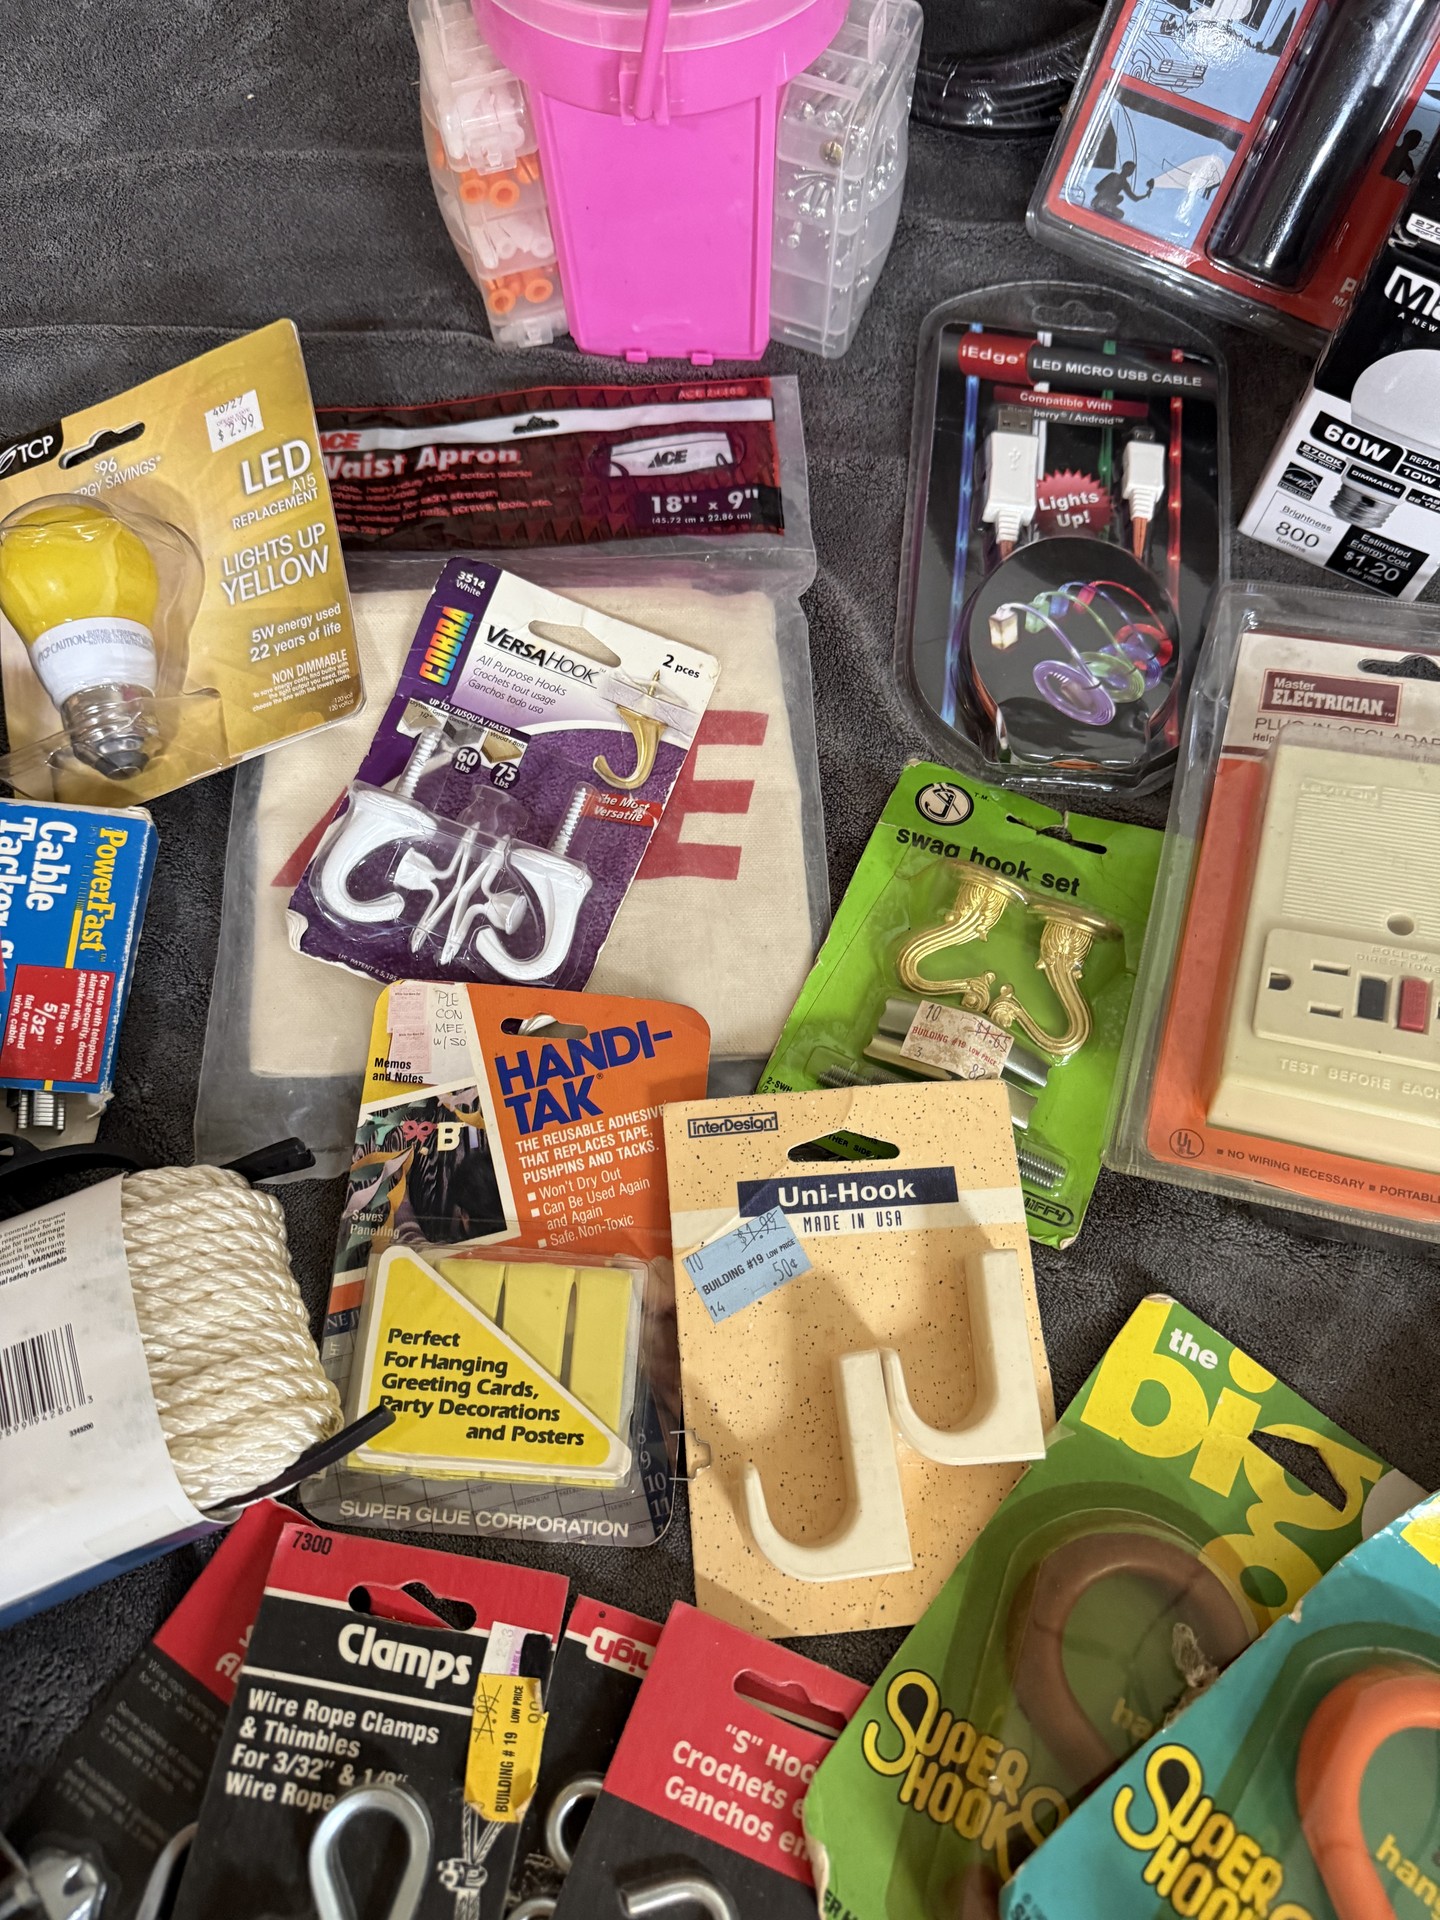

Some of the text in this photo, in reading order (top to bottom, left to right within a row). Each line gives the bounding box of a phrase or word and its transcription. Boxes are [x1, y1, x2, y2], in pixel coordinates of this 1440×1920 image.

[962, 345, 1019, 365] iEdge
[1033, 359, 1202, 388] LED MICRO USB CABLE
[1020, 391, 1112, 412] Compatible With
[17, 435, 54, 463] TCP
[1323, 423, 1391, 462] 60W
[94, 457, 118, 476] $96
[241, 439, 312, 495] LED
[415, 446, 521, 472] Apron
[648, 449, 688, 469] ACE
[292, 472, 316, 494] A15
[1351, 469, 1401, 493] DIMMABLE
[1403, 468, 1436, 485] 10W
[232, 487, 318, 530] REPLACEMENT
[651, 488, 759, 514] 18" 9"
[1039, 491, 1099, 511] Lights
[1056, 511, 1090, 528] Up!
[1282, 505, 1333, 532] Brightness
[1275, 520, 1320, 548] 800
[1361, 533, 1411, 559] Estimated
[223, 522, 326, 577] LIGHTS UP
[1350, 538, 1411, 569] Energy Cost
[220, 545, 329, 606] YELLOW
[457, 570, 487, 591] 3514
[1343, 550, 1400, 582] $1.20
[455, 579, 482, 598] White
[252, 603, 341, 643] 5W energy used
[250, 622, 342, 662] 22 years of life
[486, 624, 600, 684] VERSAHOOK
[272, 649, 348, 685] NON DIMMABLE
[476, 654, 567, 697] All Purpose Hooks
[661, 654, 701, 680] 2 pces
[468, 679, 544, 716] Ganchos todo uso
[472, 667, 556, 708] Crochets tout usage
[1274, 677, 1316, 692] Master
[1271, 688, 1384, 717] ELECTRICIAN
[454, 760, 471, 774] Lbs
[457, 749, 477, 766] 60
[499, 763, 518, 781] 75
[493, 777, 510, 789] Lbs
[26, 821, 78, 911] Cable
[896, 826, 1081, 897] swag hook set
[80, 827, 129, 952] PowerFast
[30, 1002, 58, 1042] 5/32"
[84, 974, 110, 1075] For use with telephone,
[912, 1026, 967, 1049] BUILDING #19
[374, 1057, 412, 1070] Memos
[494, 1020, 673, 1096] HANDI-
[372, 1071, 424, 1084] and Notes
[1280, 1058, 1392, 1091] TEST BEFORE
[504, 1074, 604, 1136] TAK
[516, 1119, 605, 1154] THE REUSABLE
[519, 1124, 653, 1169] THAT REPLACES TAPE,
[523, 1139, 660, 1185] PUSHPINS AND TACKS.
[1228, 1149, 1366, 1191] NO WIRING NECESSARY
[539, 1167, 622, 1201] Won't Dry Out
[543, 1177, 650, 1216] Can Be Used Again
[778, 1178, 917, 1208] Uni-Hook
[352, 1209, 384, 1223] Saves
[547, 1205, 603, 1231] and Again
[550, 1213, 634, 1247] Safe, Non-Toxic
[803, 1210, 903, 1233] MADE IN USA
[350, 1224, 400, 1240] Panelling
[28, 1247, 67, 1266] WARNING:
[39, 1256, 67, 1271] valuable
[702, 1238, 796, 1296] BUILDING #19 LOW PRICE
[387, 1328, 460, 1348] Perfect
[1168, 1328, 1219, 1370] the
[383, 1351, 508, 1379] For Hanging
[381, 1373, 540, 1401] Greeting Cards,
[438, 1398, 560, 1422] Decorations
[465, 1423, 585, 1446] and Posters
[1080, 1297, 1384, 1640] big
[340, 1500, 630, 1538] SUPER GLUE CORPORATION
[291, 1530, 332, 1555] 7300
[337, 1623, 473, 1689] Clamps
[514, 1685, 524, 1707] PRICE
[247, 1687, 440, 1746] Wire Rope Clamps
[510, 1708, 520, 1724] LOW
[239, 1716, 361, 1759] & Thimbles
[504, 1731, 518, 1746] 19
[862, 1668, 1029, 1806] SUPER
[232, 1743, 356, 1787] For 3/32" &
[502, 1749, 515, 1758] #
[495, 1761, 515, 1813] BUILDING
[672, 1740, 788, 1811] Crochets
[224, 1771, 337, 1814] Wire Rope
[664, 1775, 774, 1842] Ganchos
[1112, 1743, 1283, 1916] SUPER
